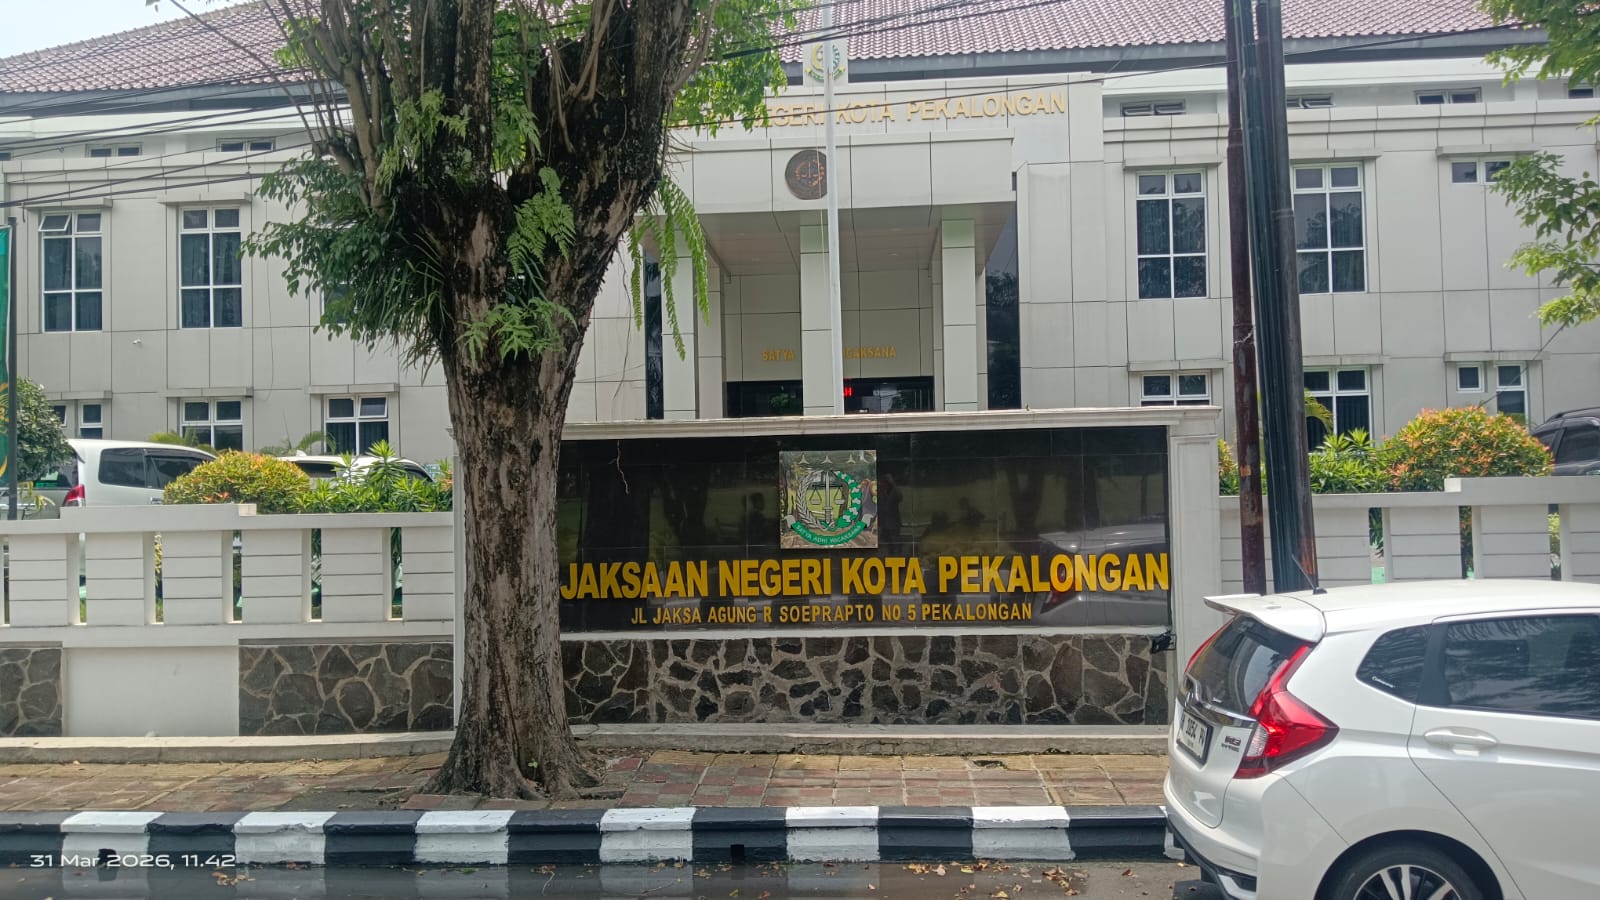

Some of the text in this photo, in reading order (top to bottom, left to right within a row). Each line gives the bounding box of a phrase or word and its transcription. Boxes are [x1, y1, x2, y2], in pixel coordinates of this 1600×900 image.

[835, 99, 896, 124] KOTA
[907, 92, 1065, 121] PEKALONGAN
[762, 349, 795, 361] SATYA
[559, 552, 1170, 599] JAKSAAN NEGERI KOTA PEKALONGAN
[631, 602, 1033, 625] JL JAKSA AGUNG R SOEPRAPTO NO 5 PEKALONGAN
